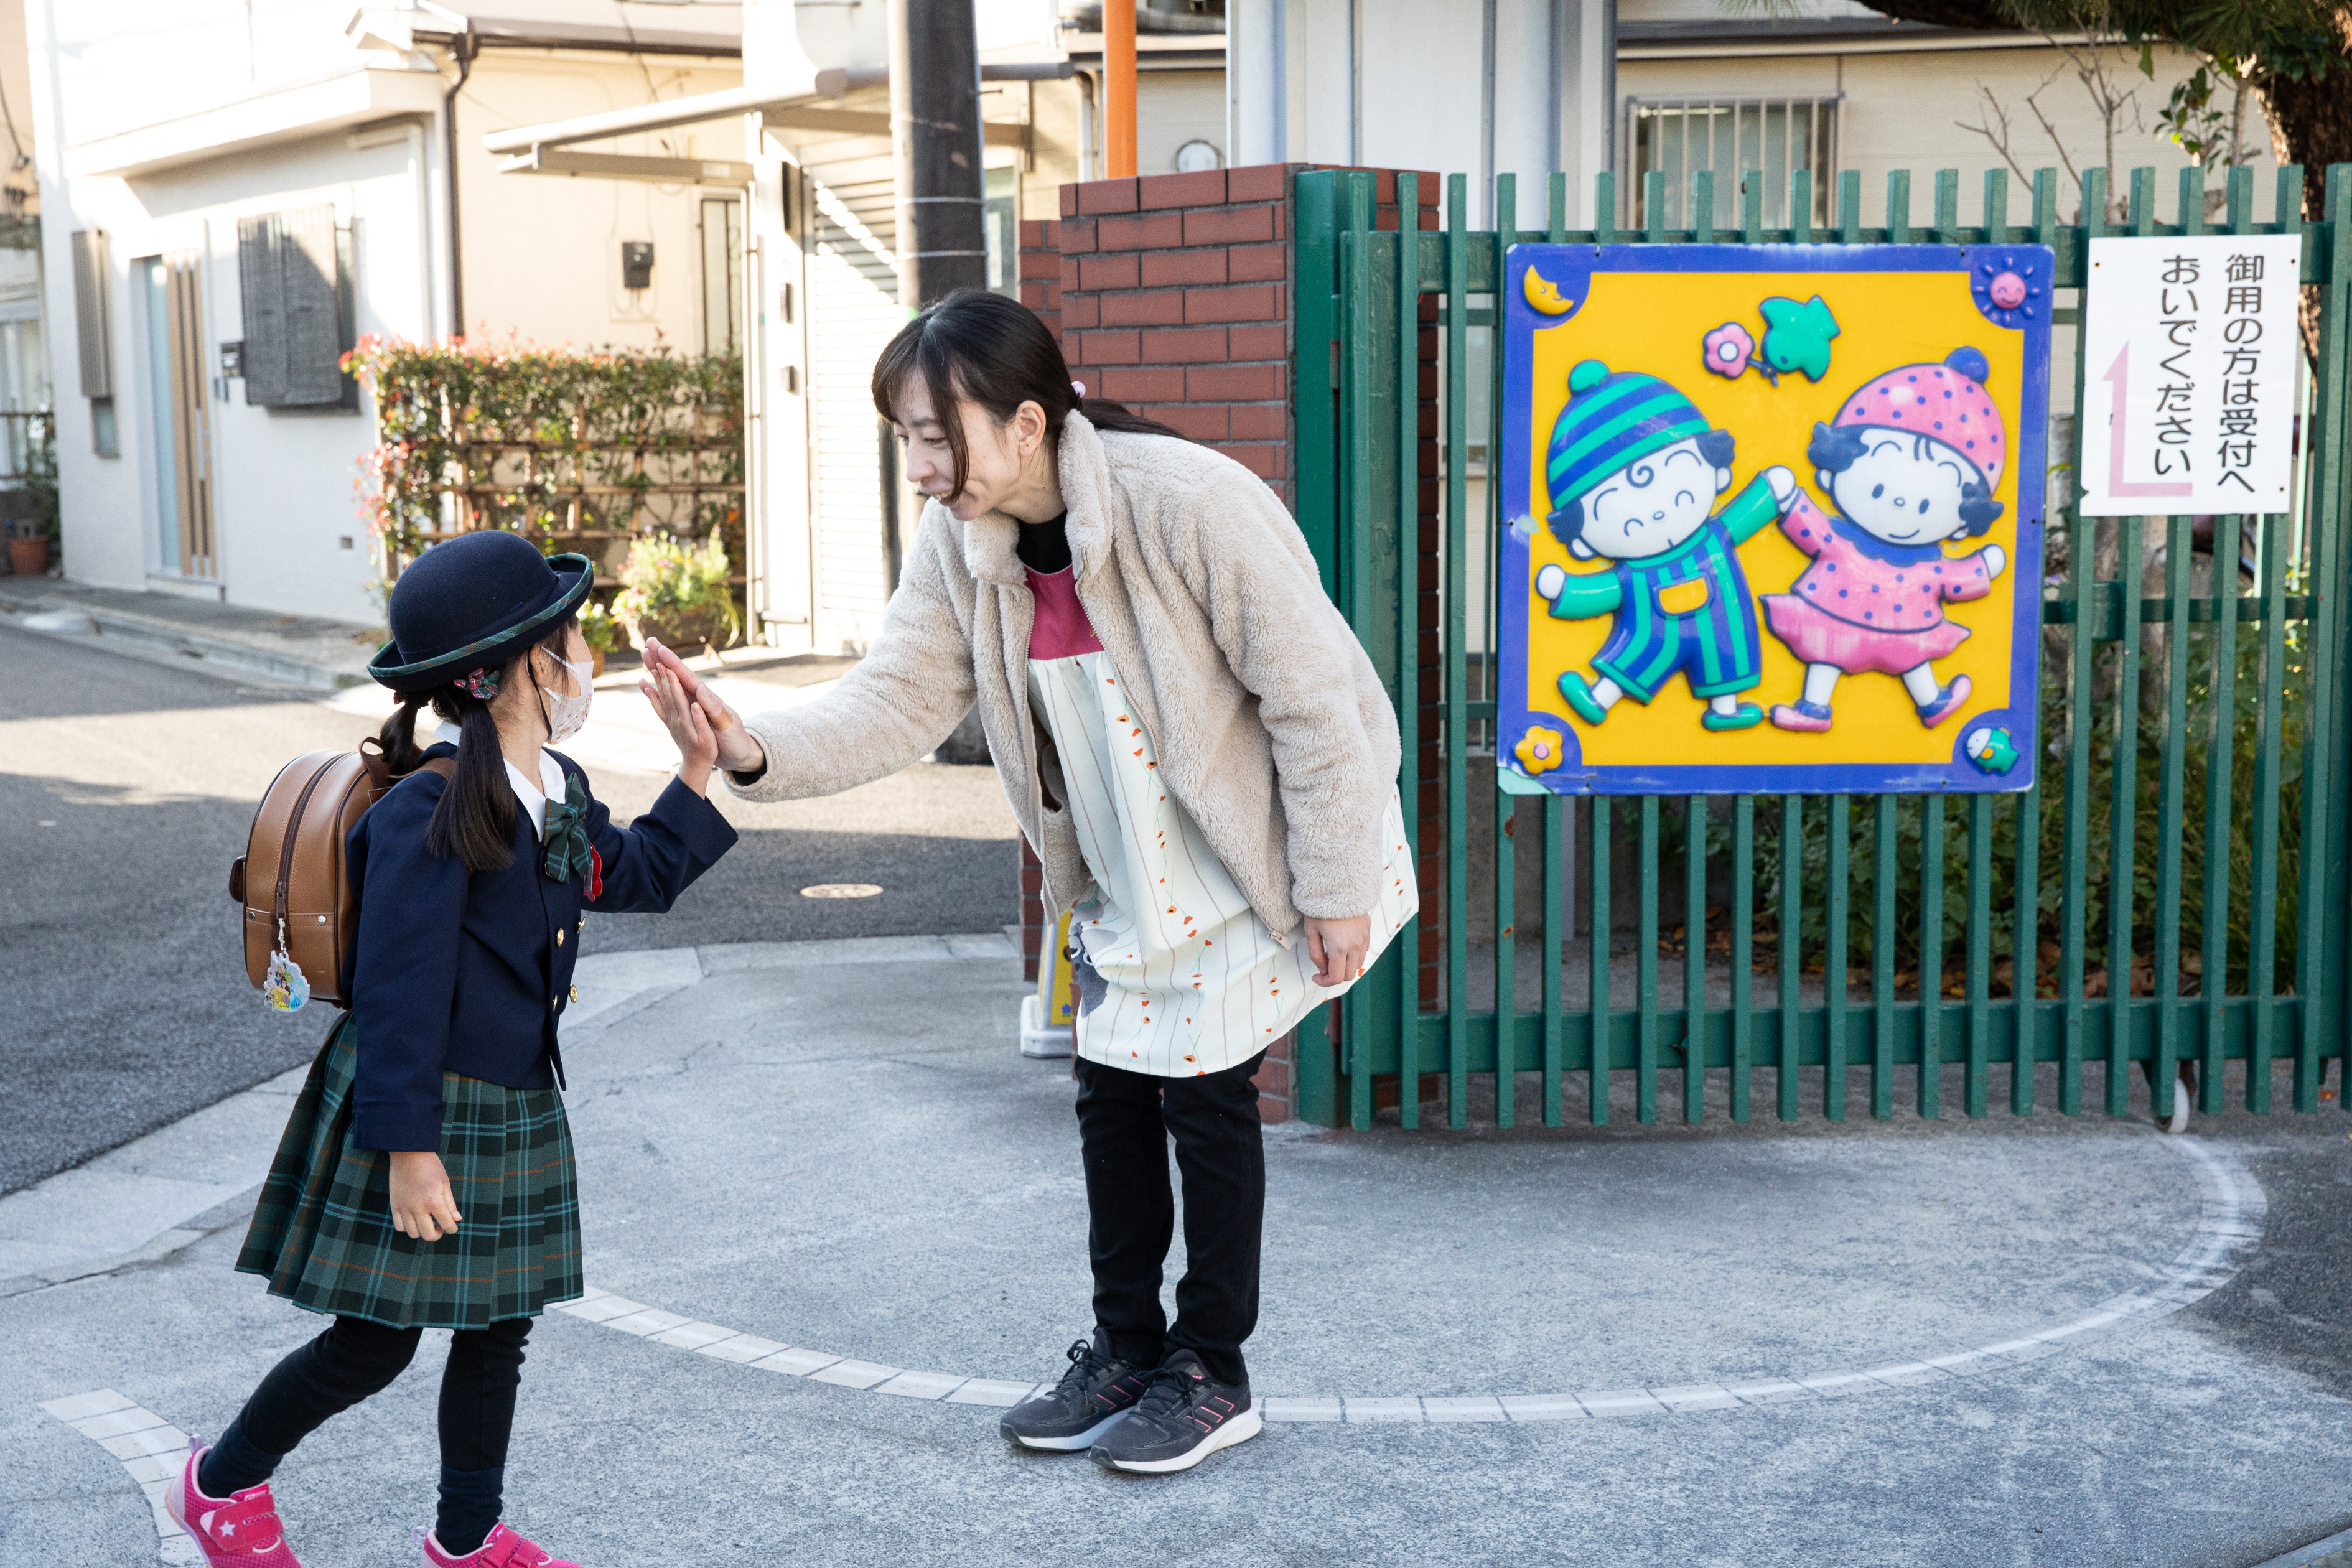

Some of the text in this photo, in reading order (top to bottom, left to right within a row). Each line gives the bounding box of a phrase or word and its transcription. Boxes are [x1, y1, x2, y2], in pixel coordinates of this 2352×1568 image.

[2155, 255, 2200, 475] おいでください
[2217, 254, 2264, 493] 御用の方は受付へ
